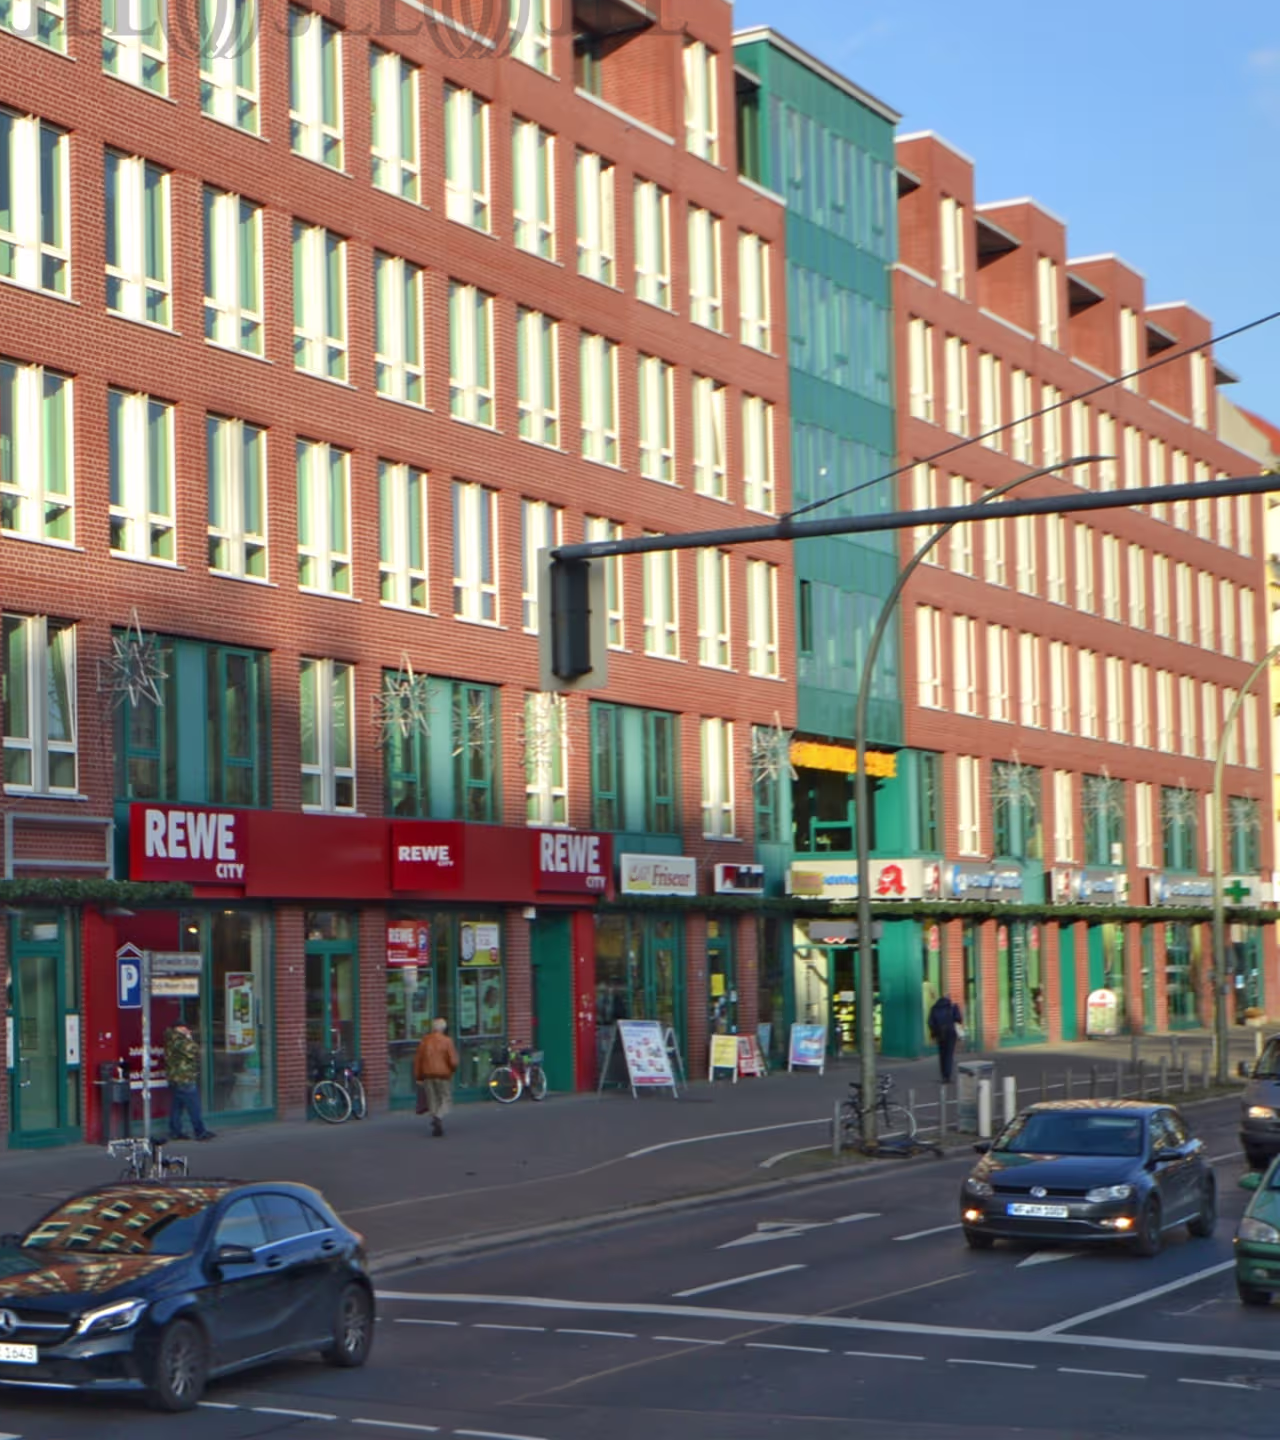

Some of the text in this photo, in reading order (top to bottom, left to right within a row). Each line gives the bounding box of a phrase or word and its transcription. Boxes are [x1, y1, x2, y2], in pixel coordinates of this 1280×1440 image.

[145, 809, 236, 861] REWE
[398, 846, 450, 861] REWE
[541, 833, 600, 873] REWE
[215, 863, 244, 879] CITY
[585, 876, 606, 888] CITY
[121, 964, 139, 1002] P
